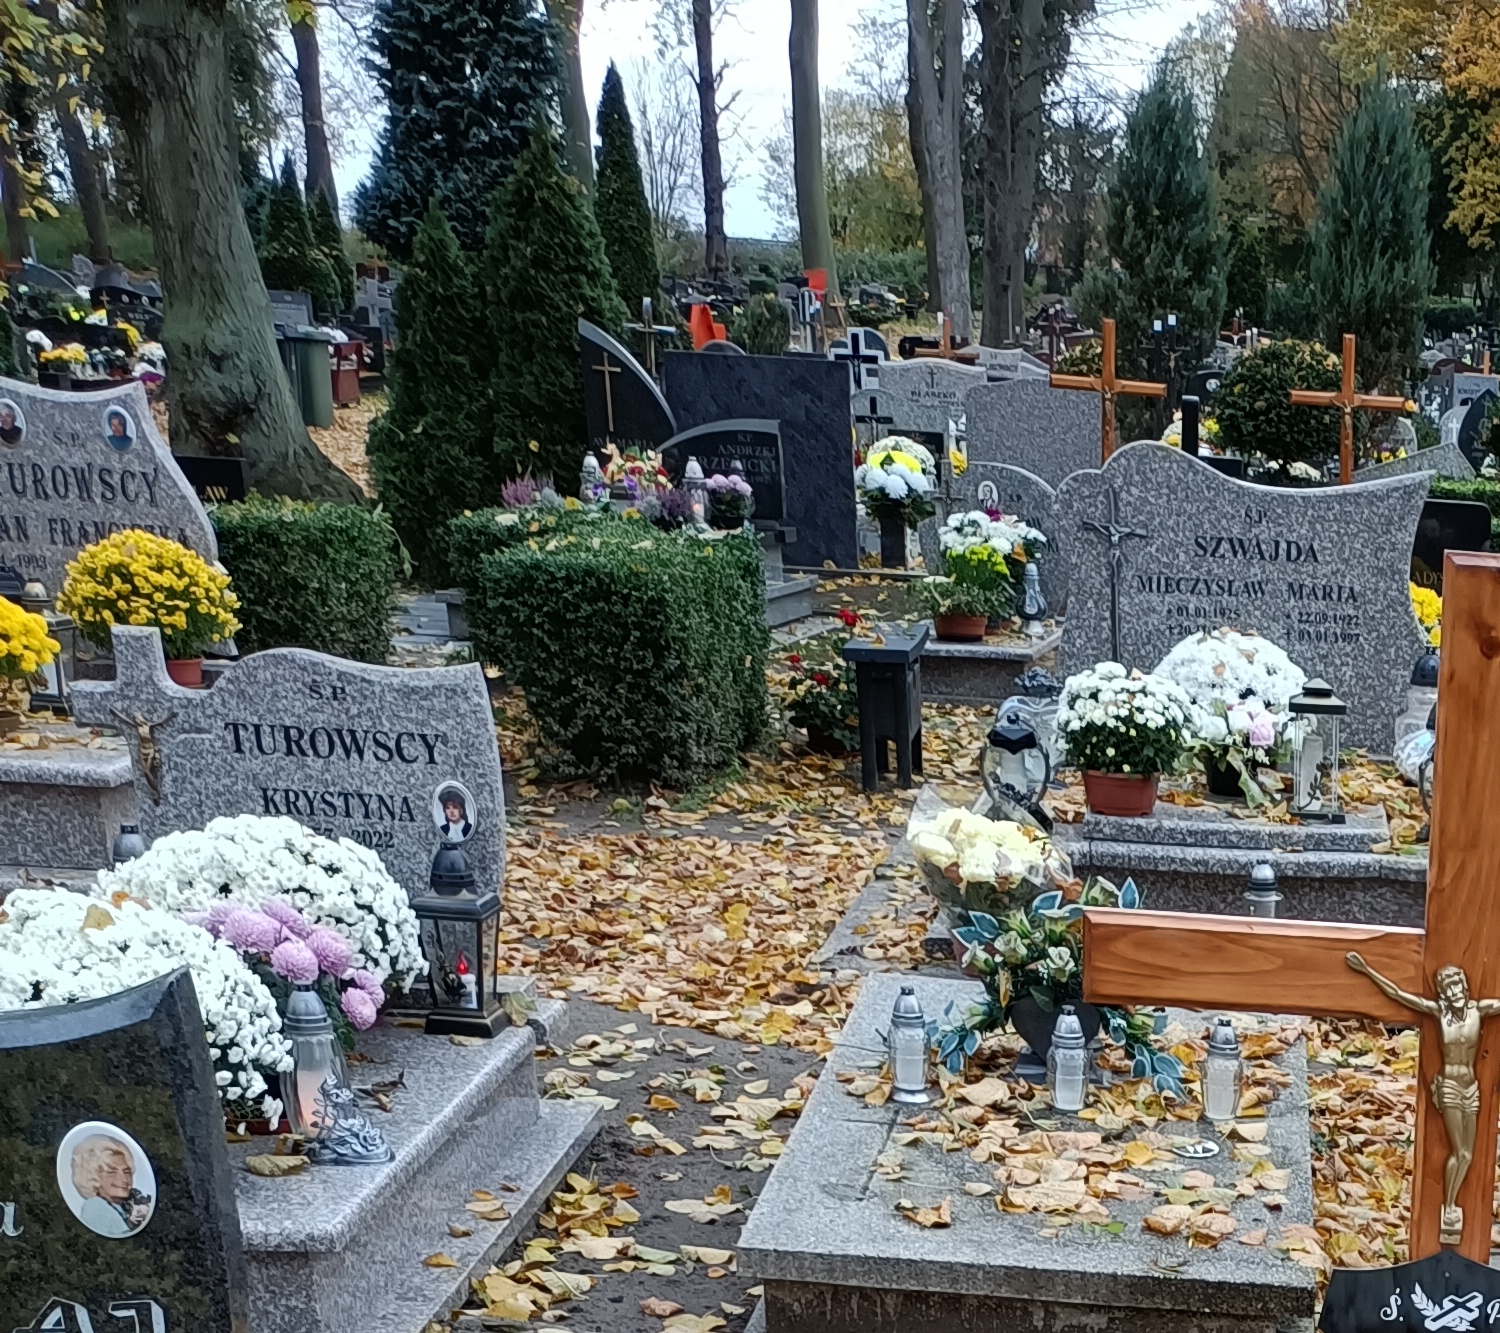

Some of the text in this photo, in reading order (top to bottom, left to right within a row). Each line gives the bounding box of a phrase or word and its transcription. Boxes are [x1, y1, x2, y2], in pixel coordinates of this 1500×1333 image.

[0, 460, 159, 508] UROWSCY
[1194, 536, 1320, 563] SZWAJDA
[1288, 581, 1358, 603] MARIA
[224, 722, 442, 765] TUROWSCY
[260, 787, 416, 823] KRYSTYNA
